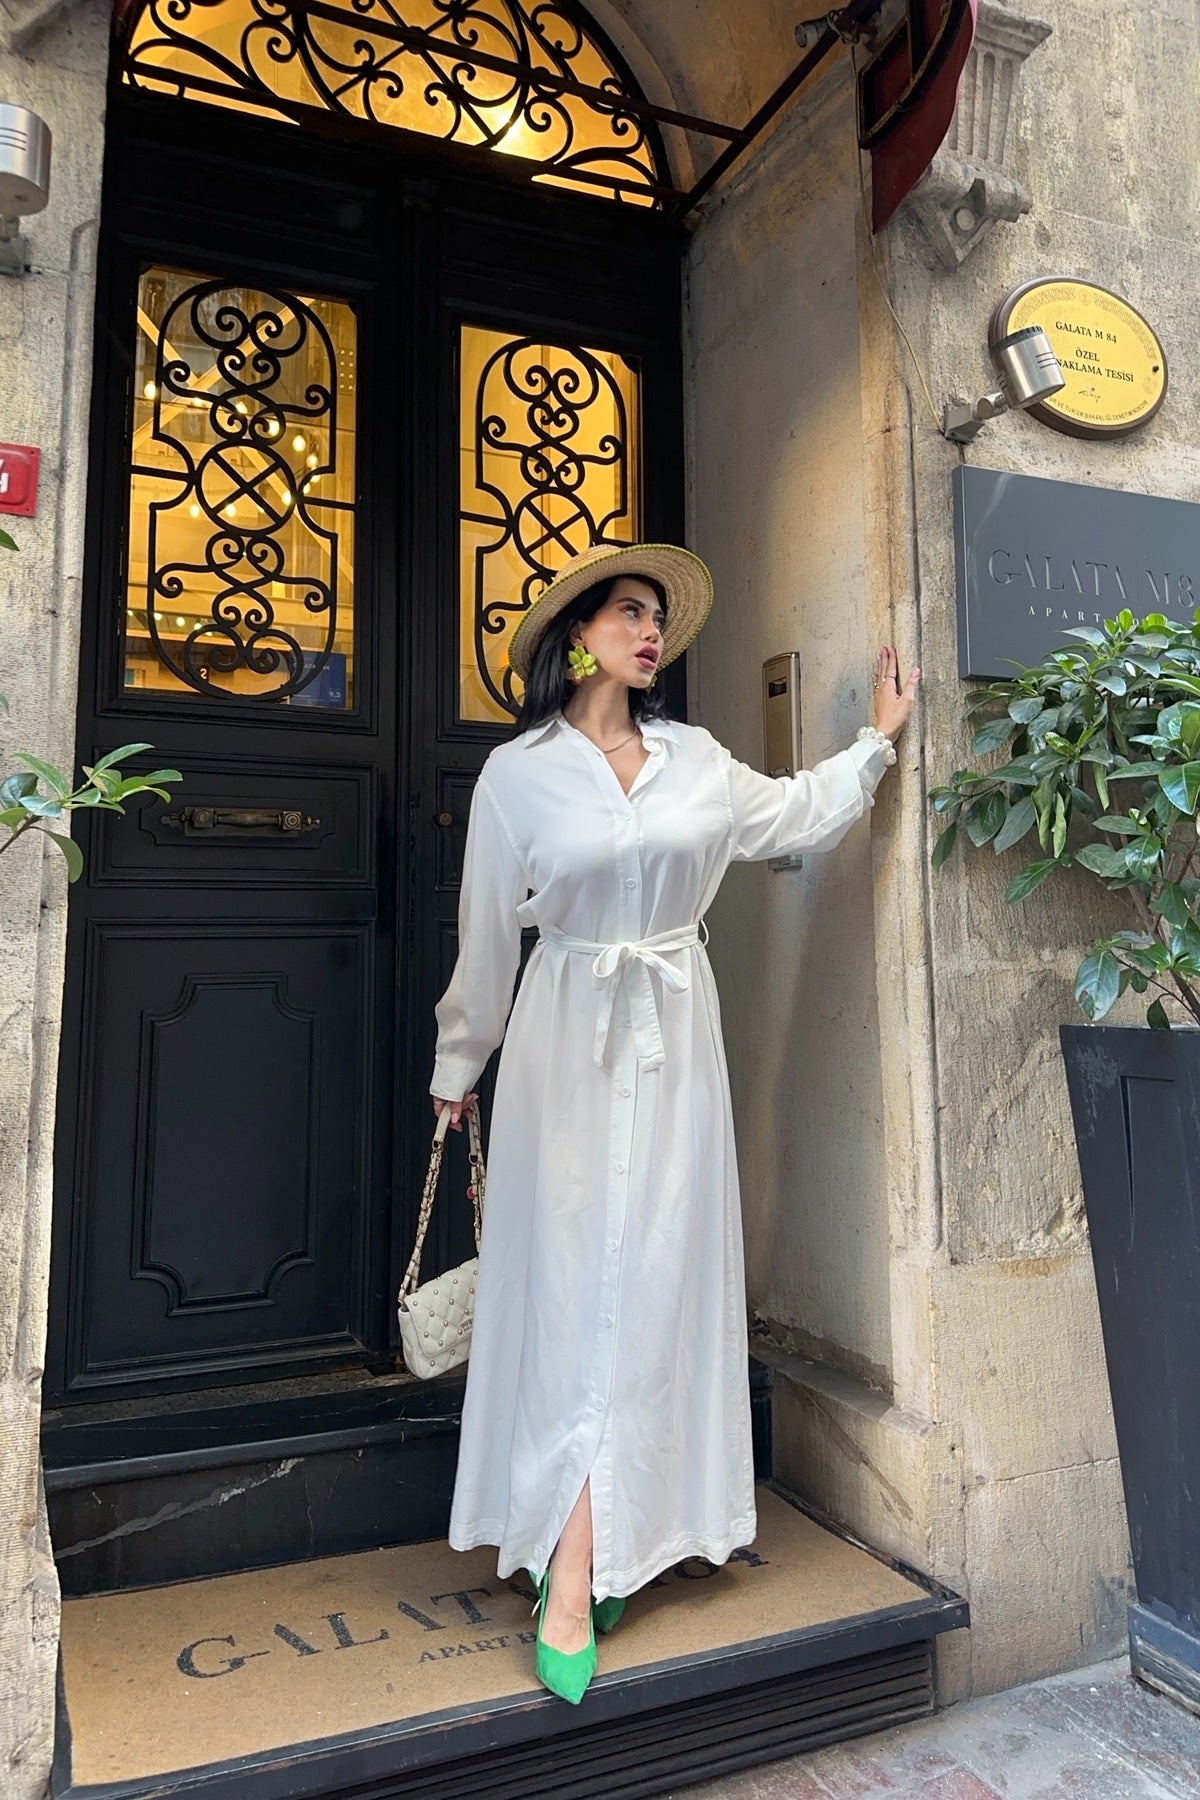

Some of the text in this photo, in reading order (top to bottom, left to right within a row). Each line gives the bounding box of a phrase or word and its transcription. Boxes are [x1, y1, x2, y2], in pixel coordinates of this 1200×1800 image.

[1055, 320, 1117, 344] GALATA M 84
[1075, 347, 1101, 363] ÖZEL
[1056, 358, 1135, 383] NAKLAMA TESİSİ
[988, 549, 1200, 608] GALATA M8
[1028, 605, 1101, 623] APART
[418, 1635, 512, 1664] APART
